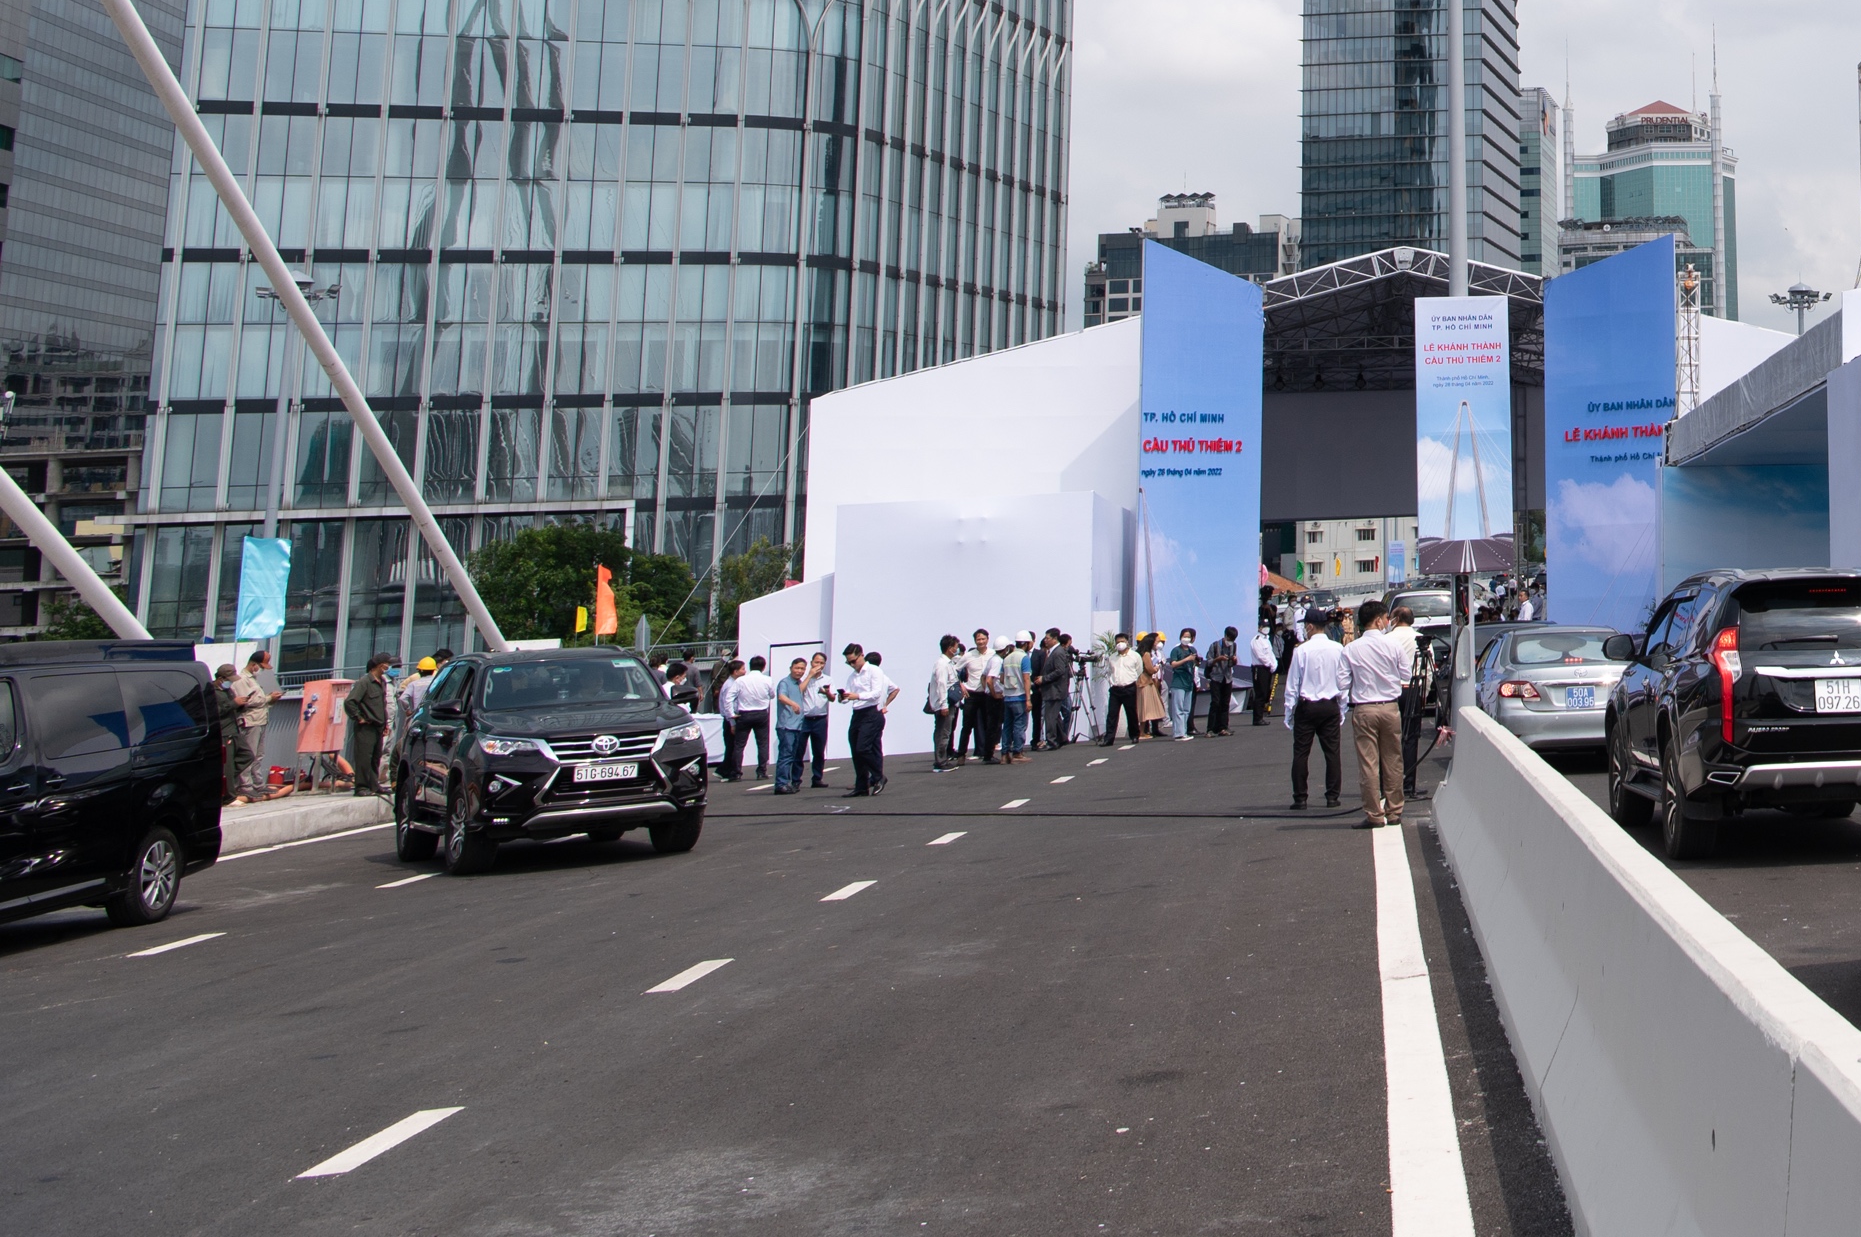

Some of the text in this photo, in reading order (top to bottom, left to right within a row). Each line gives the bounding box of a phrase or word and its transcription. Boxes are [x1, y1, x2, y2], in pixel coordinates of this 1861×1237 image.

[1641, 116, 1688, 124] PRUDENTIAL
[1437, 342, 1468, 351] KHÁNH
[1471, 341, 1501, 350] THÀNH
[1446, 355, 1464, 364] THỦ
[1467, 354, 1493, 363] THIÊM
[1603, 401, 1623, 412] BAN
[1626, 399, 1652, 410] NHÂN
[1655, 397, 1675, 407] DÂN
[1144, 412, 1158, 423] TP.
[1180, 411, 1197, 423] CHÍ
[1200, 413, 1224, 424] MINH
[1565, 423, 1663, 442] LỄ KHÁNH THÀN
[1198, 438, 1233, 453] THIÊM
[1235, 440, 1242, 453] 2
[1615, 453, 1627, 463] phố
[1643, 452, 1655, 460] Chí
[1141, 469, 1156, 478] ngày
[1166, 468, 1183, 478] tháng
[1193, 468, 1206, 476] năm
[1207, 468, 1222, 476] 2022
[1573, 688, 1589, 697] 50A
[1825, 679, 1851, 694] 51H
[1568, 697, 1594, 707] 003.95
[1817, 695, 1861, 711] 097.26
[576, 765, 636, 780] 51G-694.67
